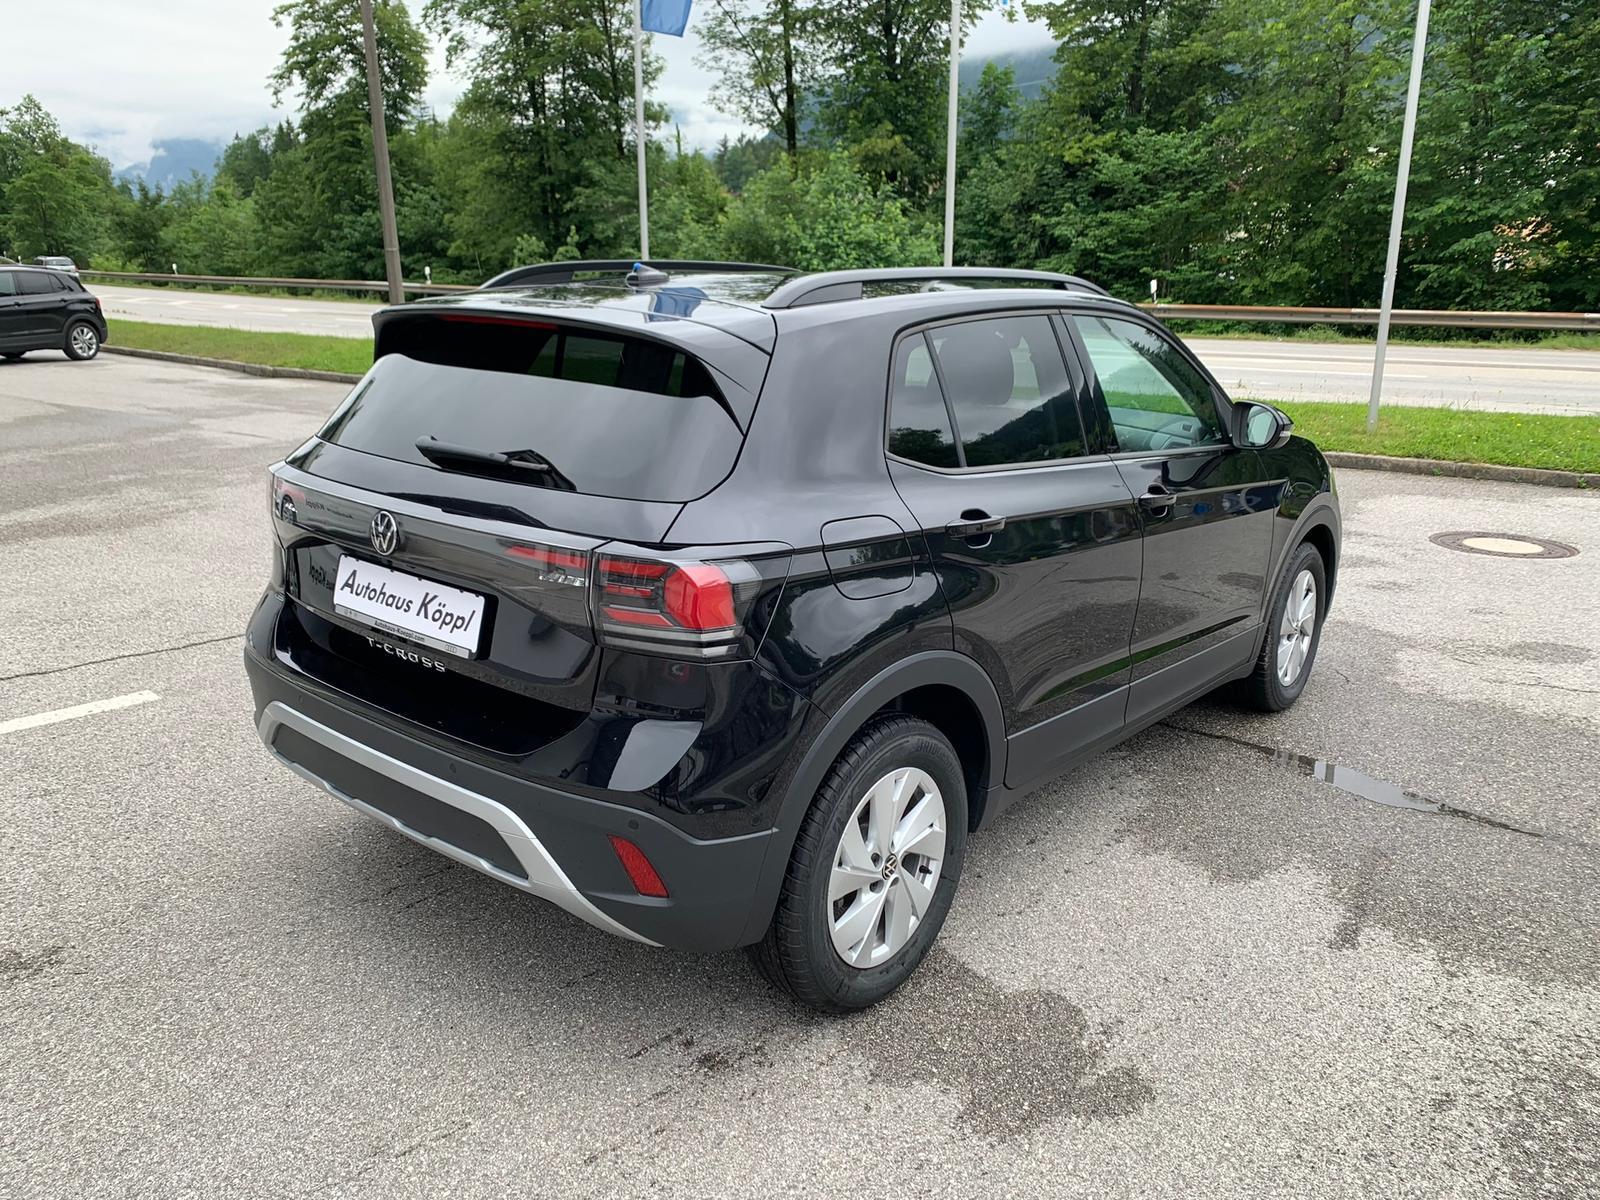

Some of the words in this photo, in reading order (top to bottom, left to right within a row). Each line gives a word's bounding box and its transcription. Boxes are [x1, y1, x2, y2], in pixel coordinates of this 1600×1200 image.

[340, 569, 413, 613] Autohaus
[416, 592, 476, 634] Köppl
[366, 636, 446, 673] T-CROSS
